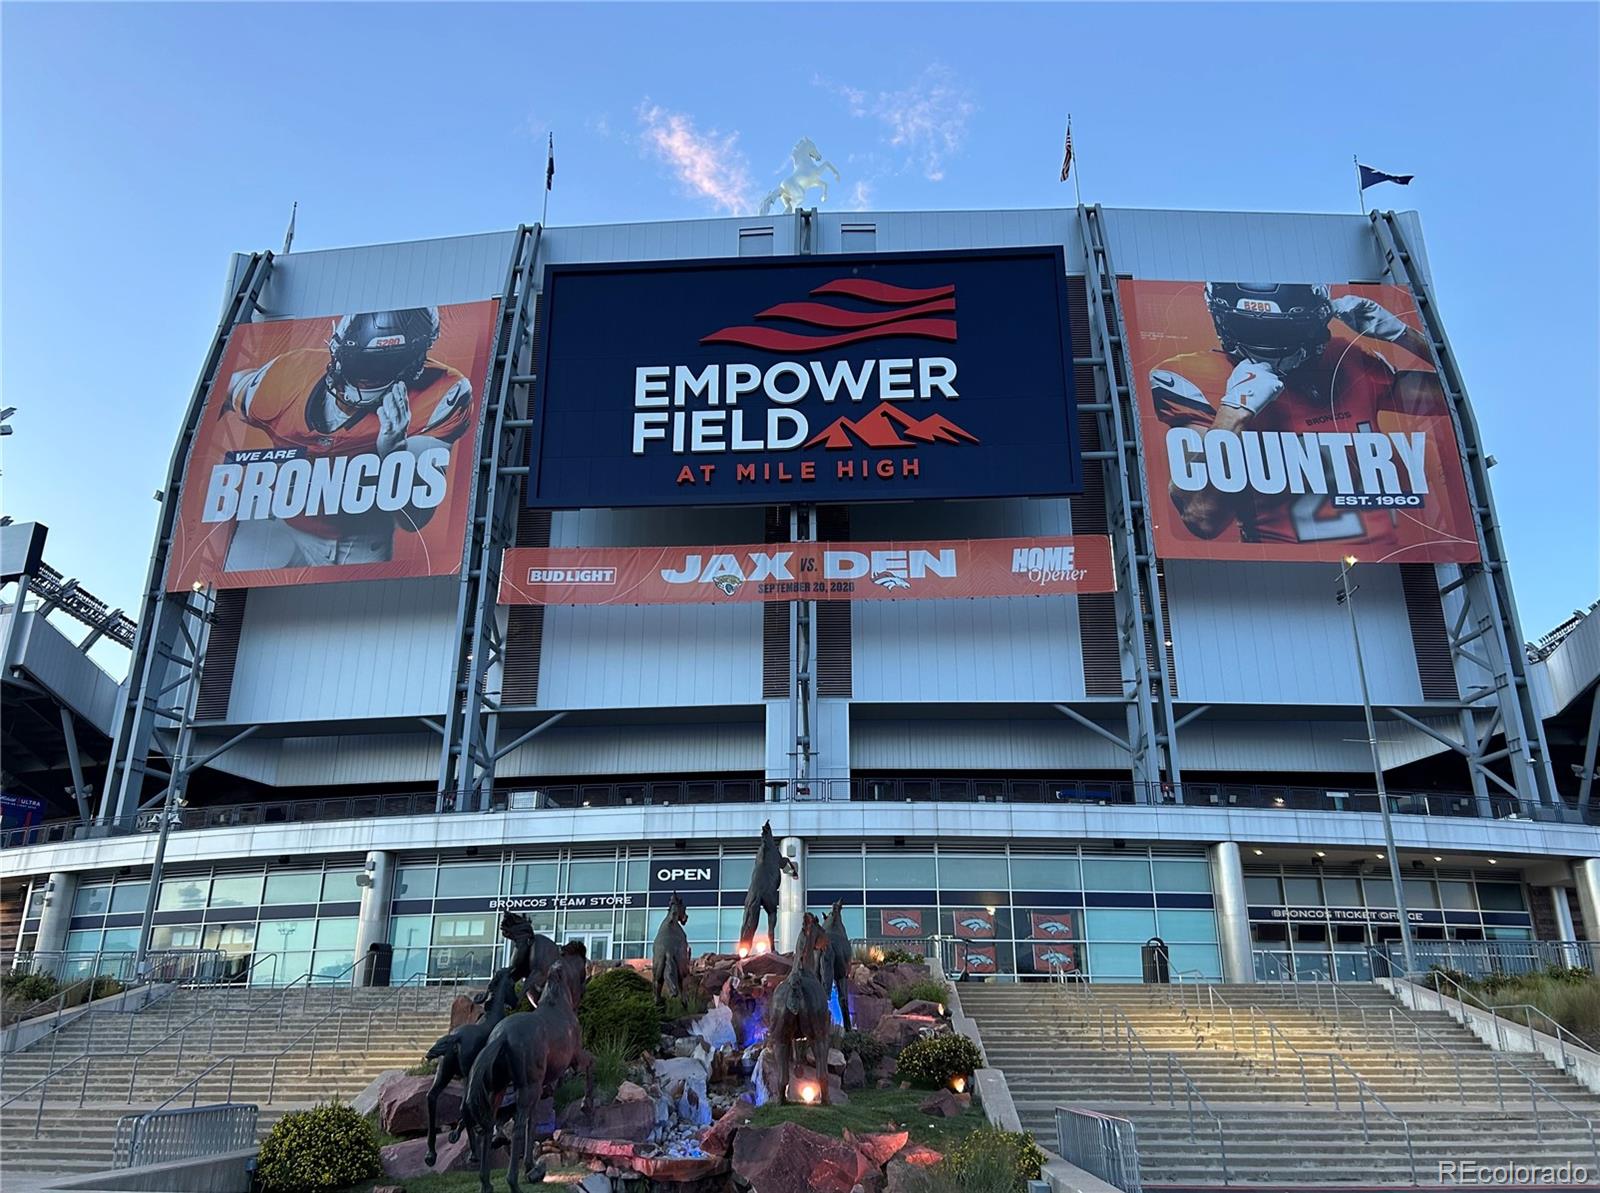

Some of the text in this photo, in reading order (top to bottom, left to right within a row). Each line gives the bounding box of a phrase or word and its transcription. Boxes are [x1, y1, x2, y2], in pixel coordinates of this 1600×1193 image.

[1243, 301, 1271, 312] 5280
[634, 356, 960, 408] EMPOWER
[632, 407, 810, 455] FIELD
[235, 449, 297, 462] WE ARE
[1165, 427, 1430, 495] COUNTRY
[676, 458, 921, 484] AT MILE HIGH
[201, 447, 451, 523] BRONCOS
[1335, 495, 1421, 506] EST. 1960
[660, 548, 957, 584] JAX VS. DEN
[1011, 546, 1075, 573] HOME
[530, 570, 614, 582] BUD LIGHT
[1028, 567, 1088, 586] Opener
[758, 582, 811, 594] SEPTEMBER
[657, 868, 711, 882] OPEN
[489, 896, 632, 909] BRONCOS TEAM STORE
[1272, 909, 1332, 918] BRONCOS
[1334, 910, 1378, 919] TICKET
